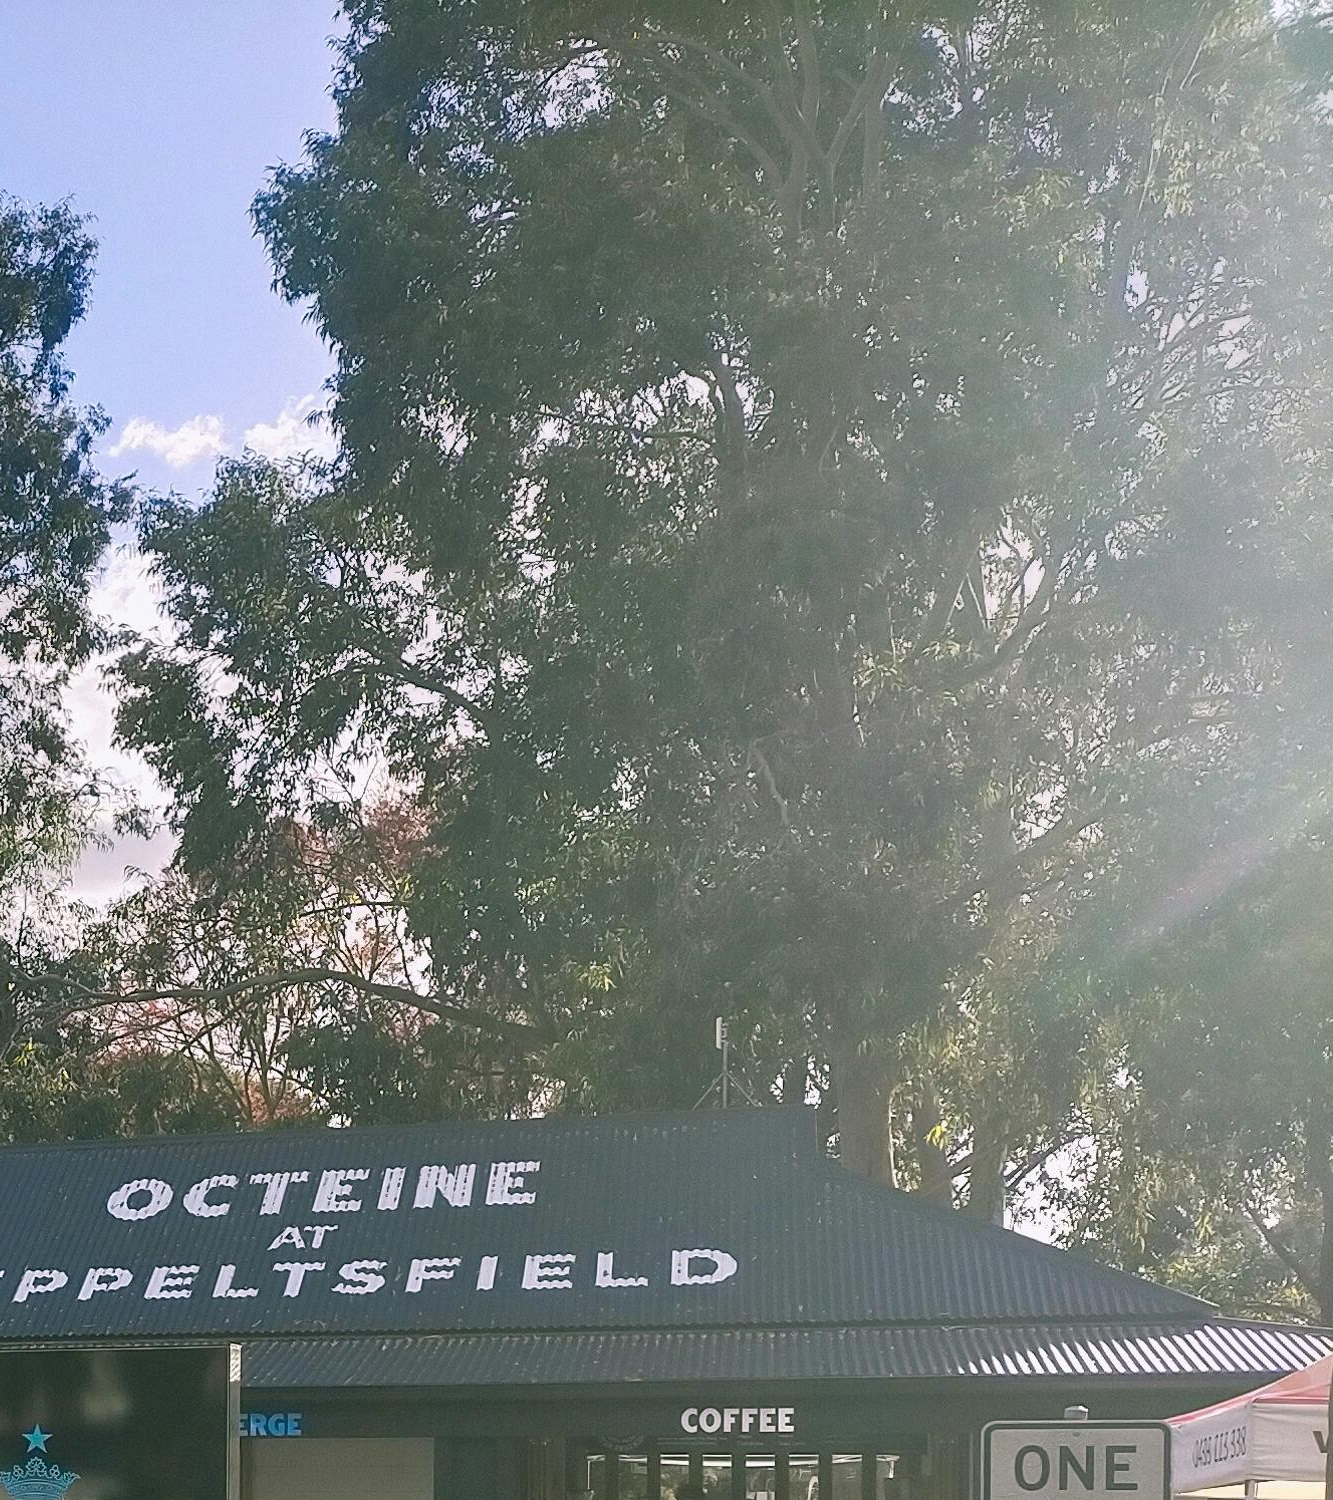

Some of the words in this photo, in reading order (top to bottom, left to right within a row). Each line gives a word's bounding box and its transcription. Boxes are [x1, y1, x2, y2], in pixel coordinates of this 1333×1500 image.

[106, 1160, 541, 1220] OCTEINE
[267, 1223, 338, 1251] AT
[681, 1408, 795, 1433] COFFEE
[1015, 1445, 1138, 1492] ONE
